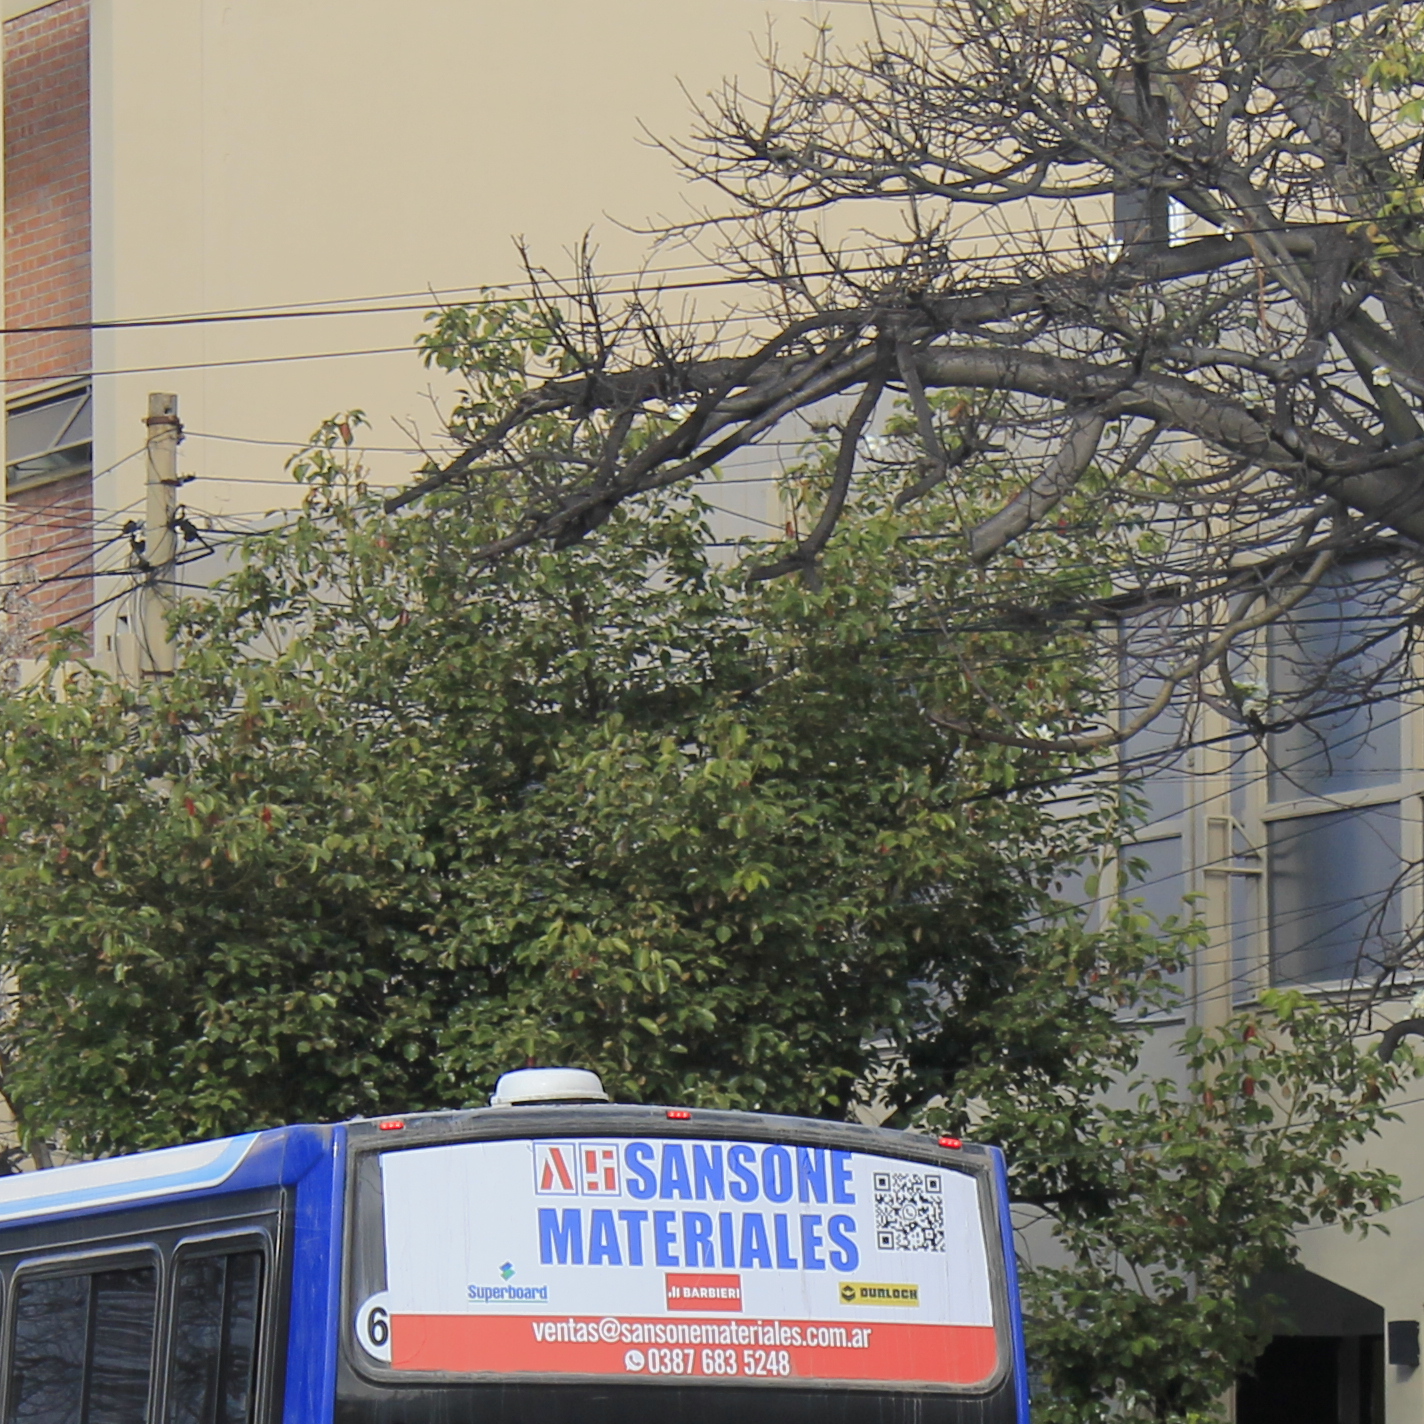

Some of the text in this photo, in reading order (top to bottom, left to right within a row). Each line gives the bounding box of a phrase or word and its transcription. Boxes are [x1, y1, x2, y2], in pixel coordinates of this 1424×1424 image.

[624, 1142, 857, 1205] SANSONE
[537, 1208, 860, 1272] MATERIALES
[468, 1285, 548, 1303] Superboard
[683, 1286, 740, 1299] BARBIERI
[367, 1306, 389, 1347] 6
[532, 1317, 872, 1349] ventas@sansonemateriales.com.ar
[648, 1349, 791, 1377] 0387 683 5248
